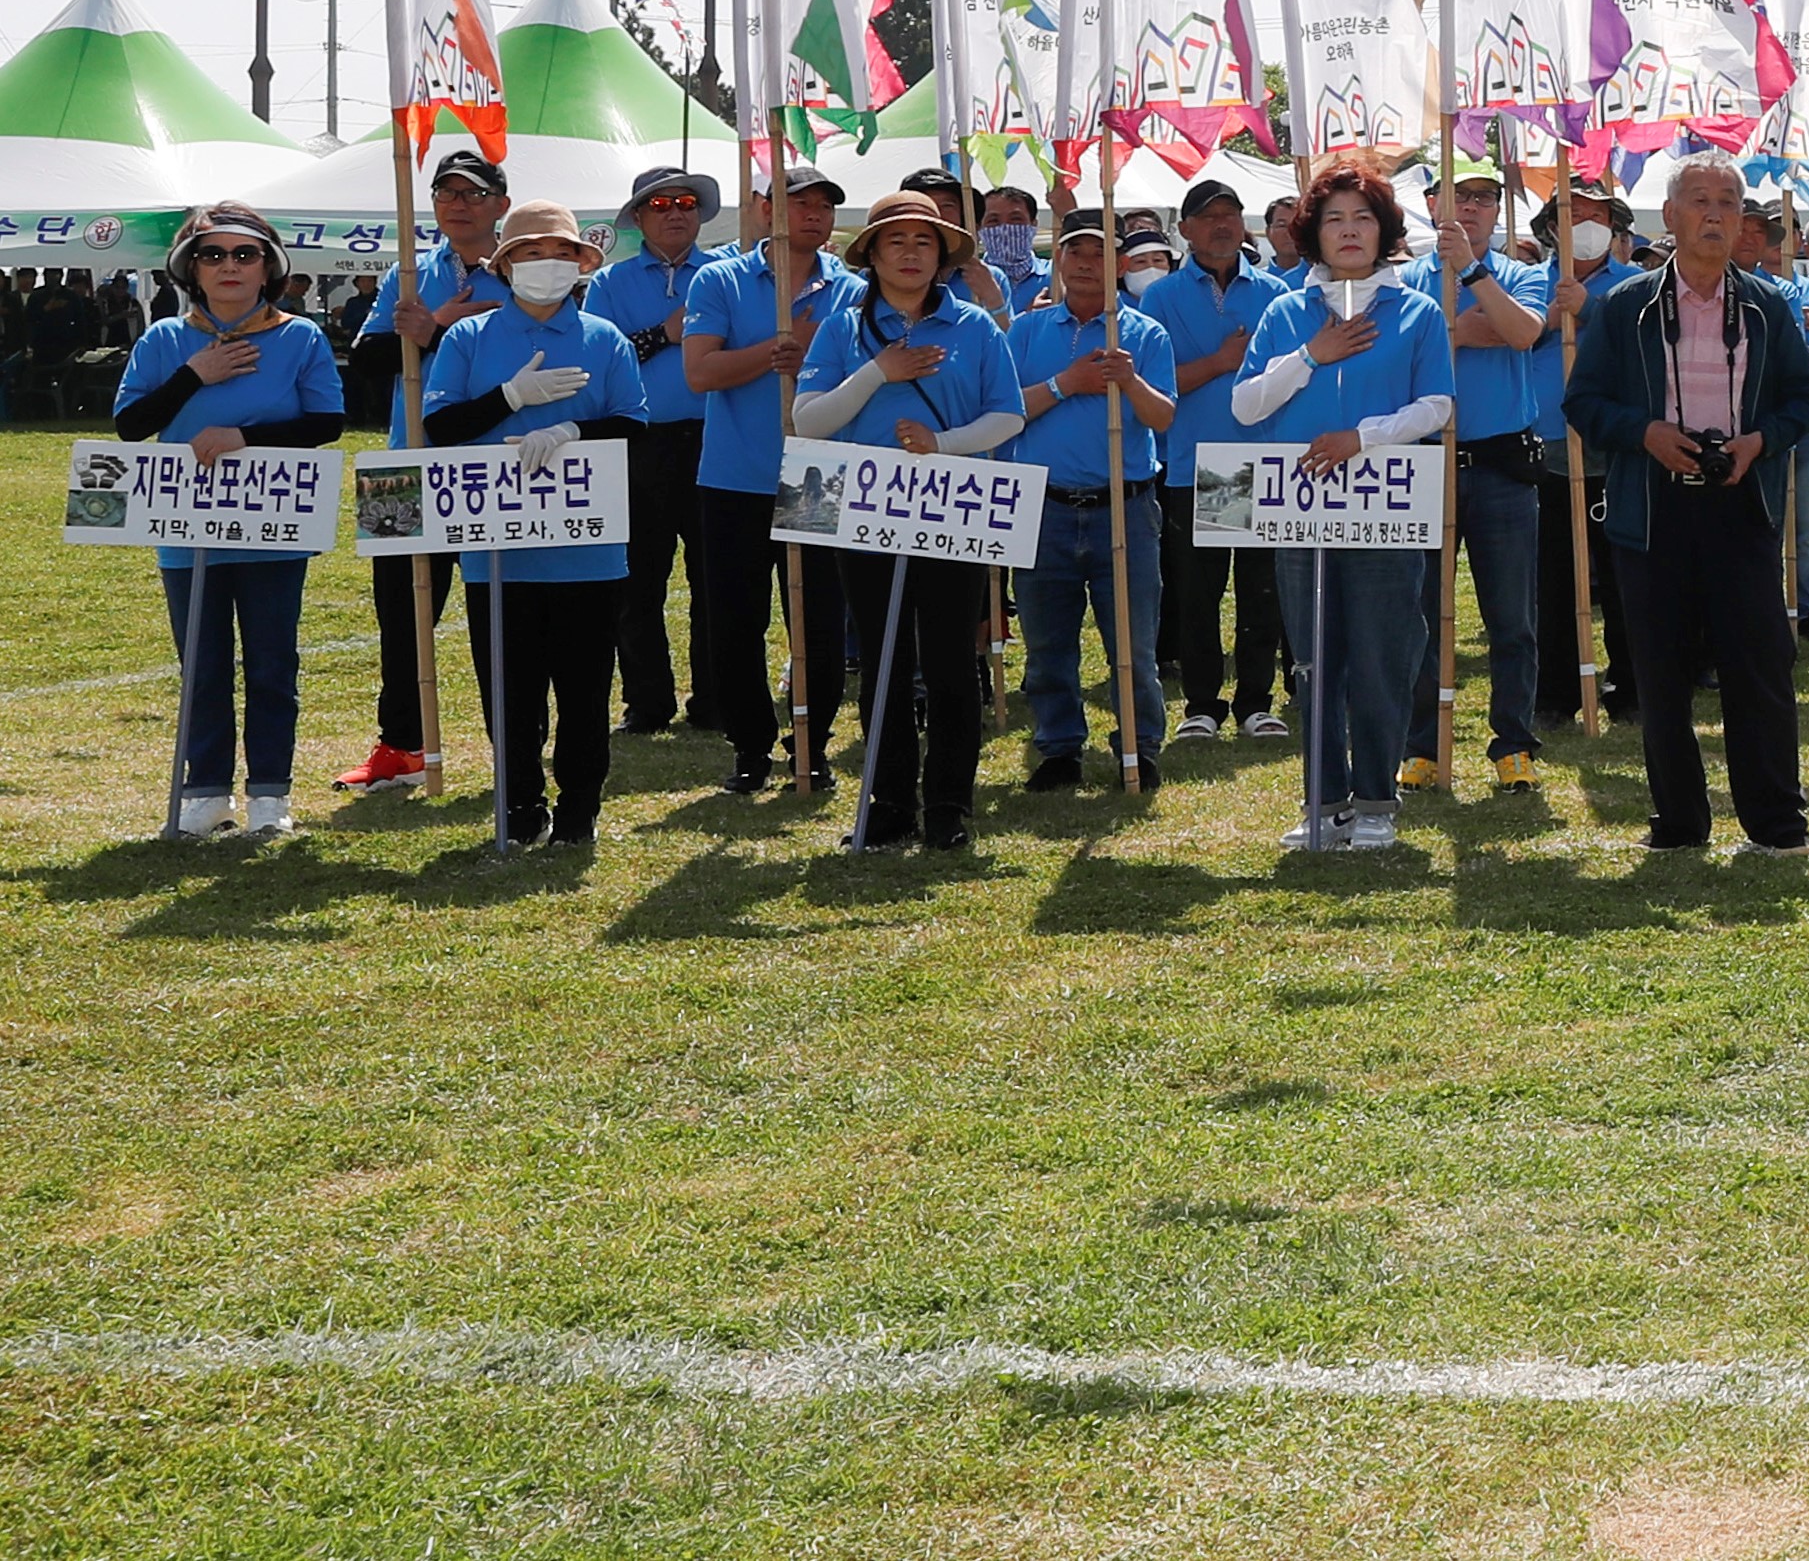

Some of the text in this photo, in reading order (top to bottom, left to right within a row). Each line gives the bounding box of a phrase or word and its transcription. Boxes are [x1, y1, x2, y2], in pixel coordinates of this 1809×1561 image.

[428, 458, 593, 517] 향동선수단
[849, 459, 1021, 530] 오산선수단
[1258, 457, 1415, 512] 고성선수단
[148, 519, 300, 541] 지막, 하율, 원포
[446, 518, 605, 543] 벌포, 모사, 향동
[852, 525, 901, 549] 오상,
